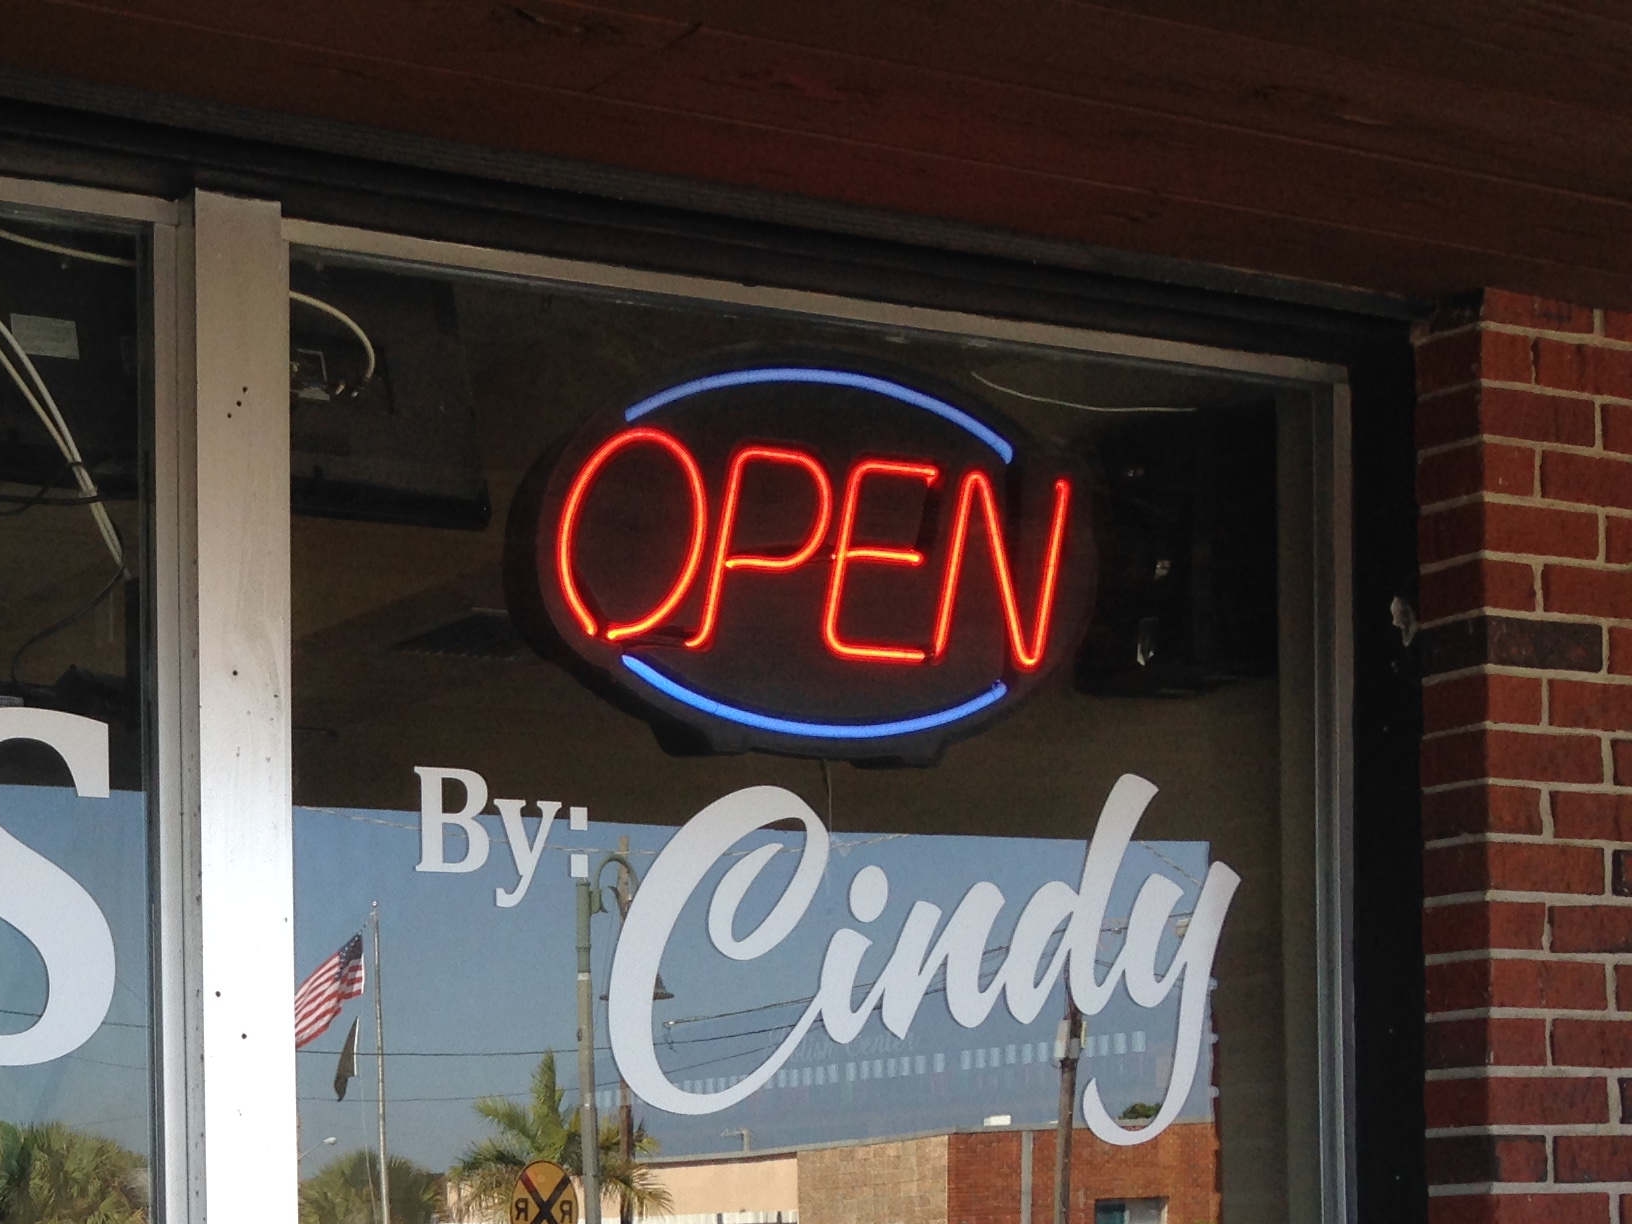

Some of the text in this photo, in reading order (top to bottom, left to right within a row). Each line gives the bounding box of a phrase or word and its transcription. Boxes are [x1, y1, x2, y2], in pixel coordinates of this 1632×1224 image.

[556, 428, 1070, 671] OPEN
[414, 766, 1241, 1146] By: Cindy
